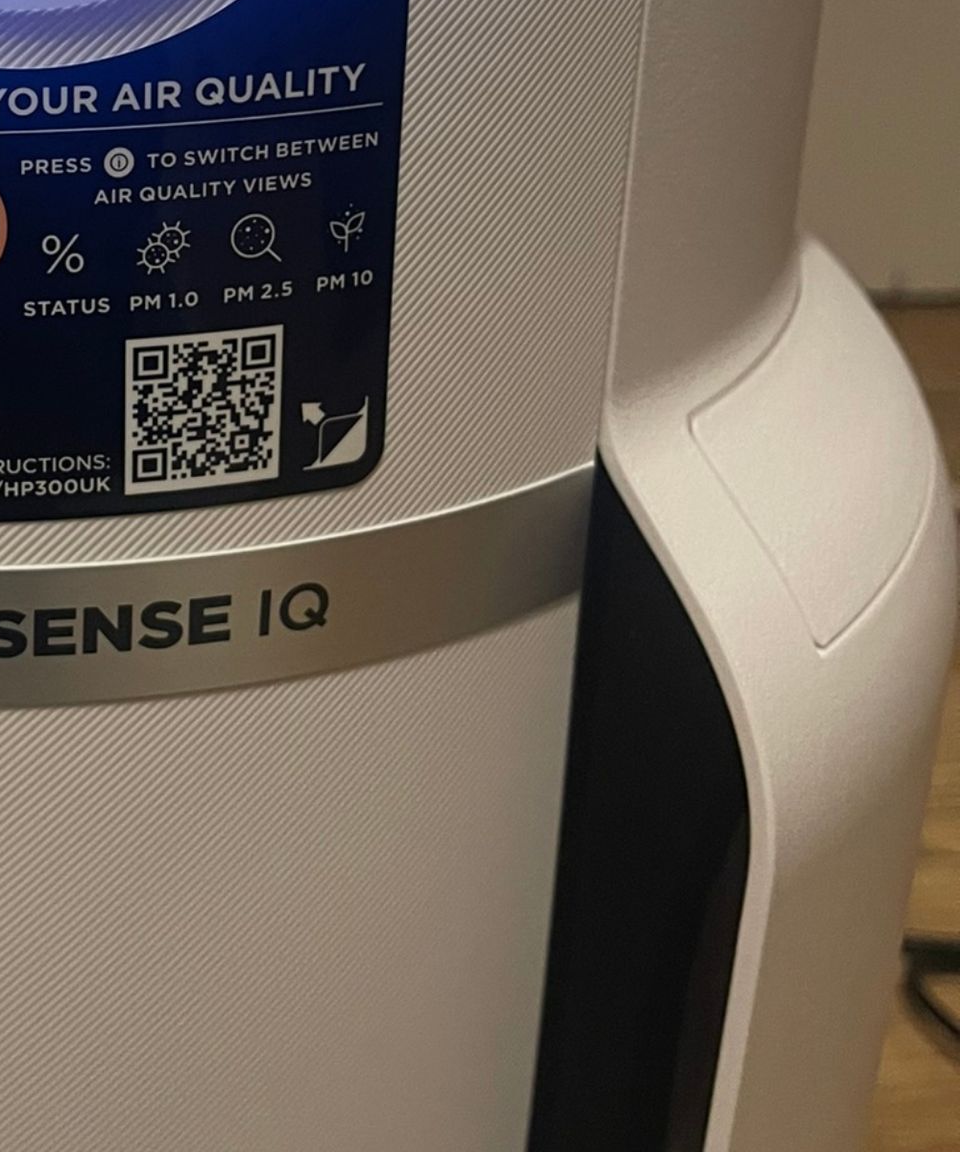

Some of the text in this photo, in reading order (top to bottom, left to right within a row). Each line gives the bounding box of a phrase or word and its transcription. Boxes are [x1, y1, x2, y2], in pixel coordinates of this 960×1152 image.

[112, 80, 182, 112] AIR
[195, 63, 366, 106] QUALITY
[20, 131, 379, 175] PRESS TO SWITCH BETWEEN
[94, 172, 312, 206] AIR QUALITY VIEWS
[223, 281, 293, 303] PM 2.5
[316, 269, 374, 292] PM 10
[23, 297, 110, 317] STATUS
[130, 291, 199, 312] PM 1.0
[259, 582, 329, 637] IQ
